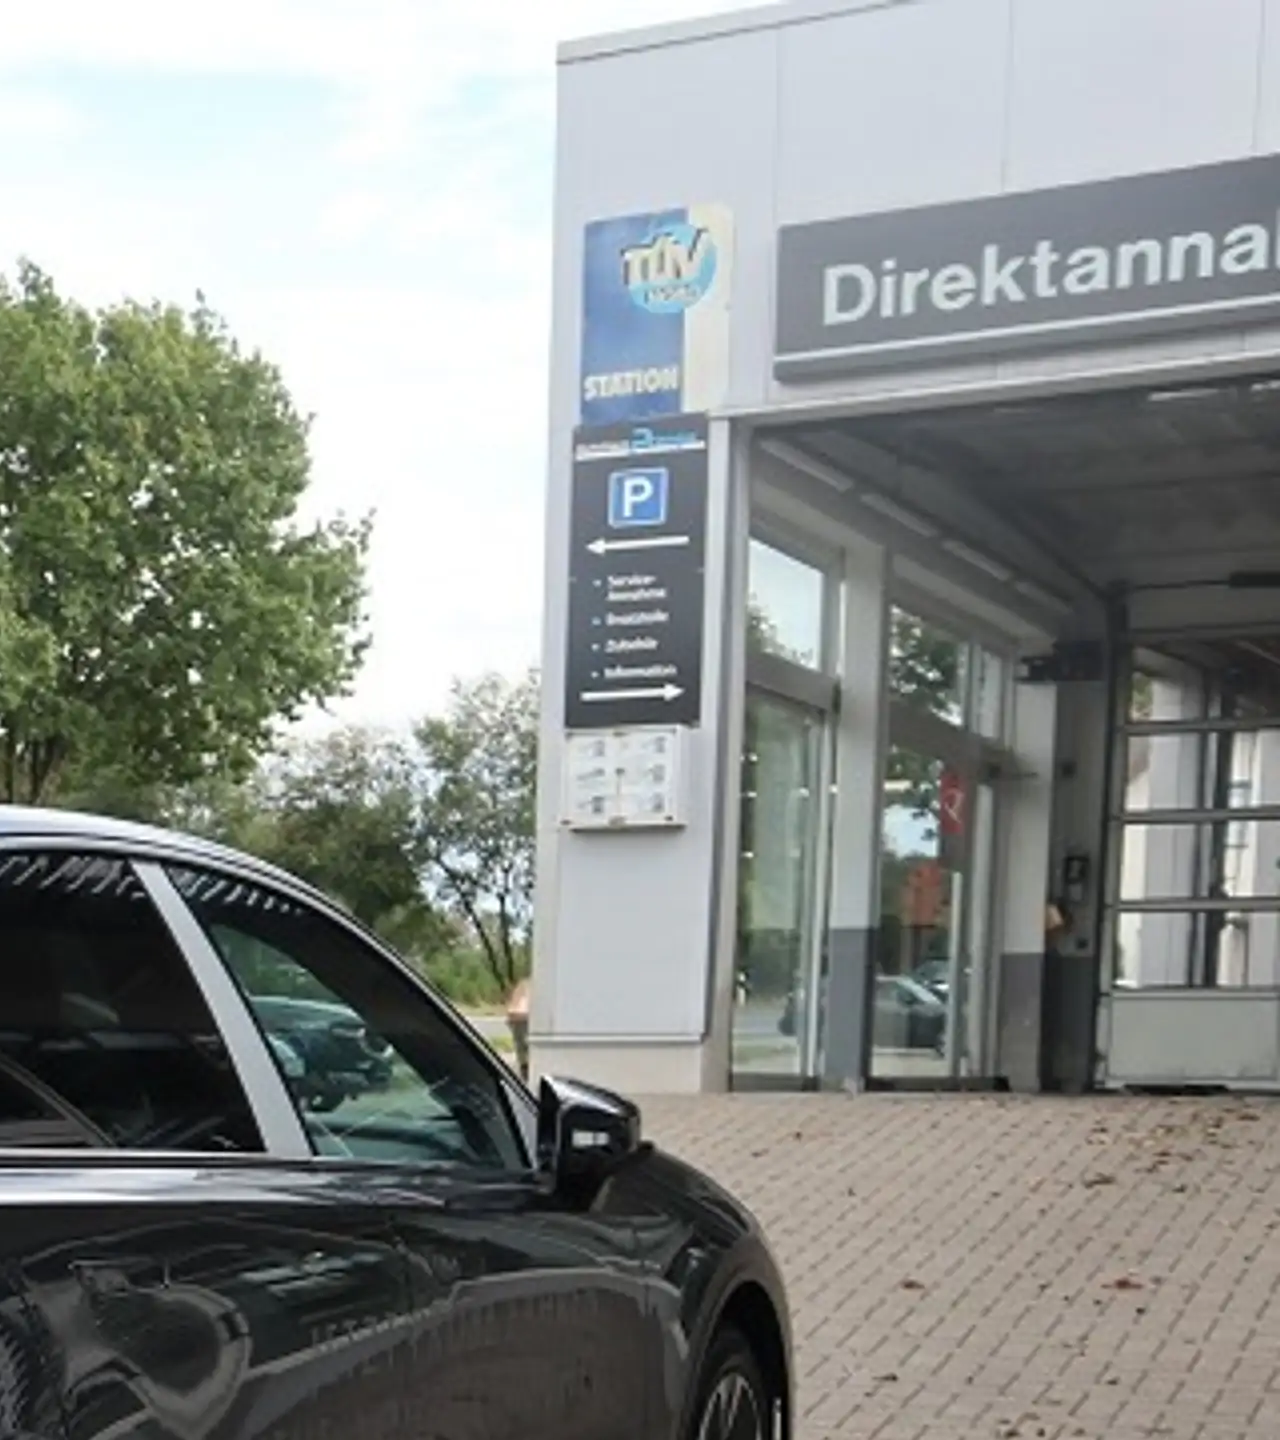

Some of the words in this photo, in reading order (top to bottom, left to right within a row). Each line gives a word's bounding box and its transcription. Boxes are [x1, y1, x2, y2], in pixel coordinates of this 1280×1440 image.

[823, 207, 1280, 326] Direktanna
[584, 367, 679, 401] STATION
[623, 476, 653, 518] P
